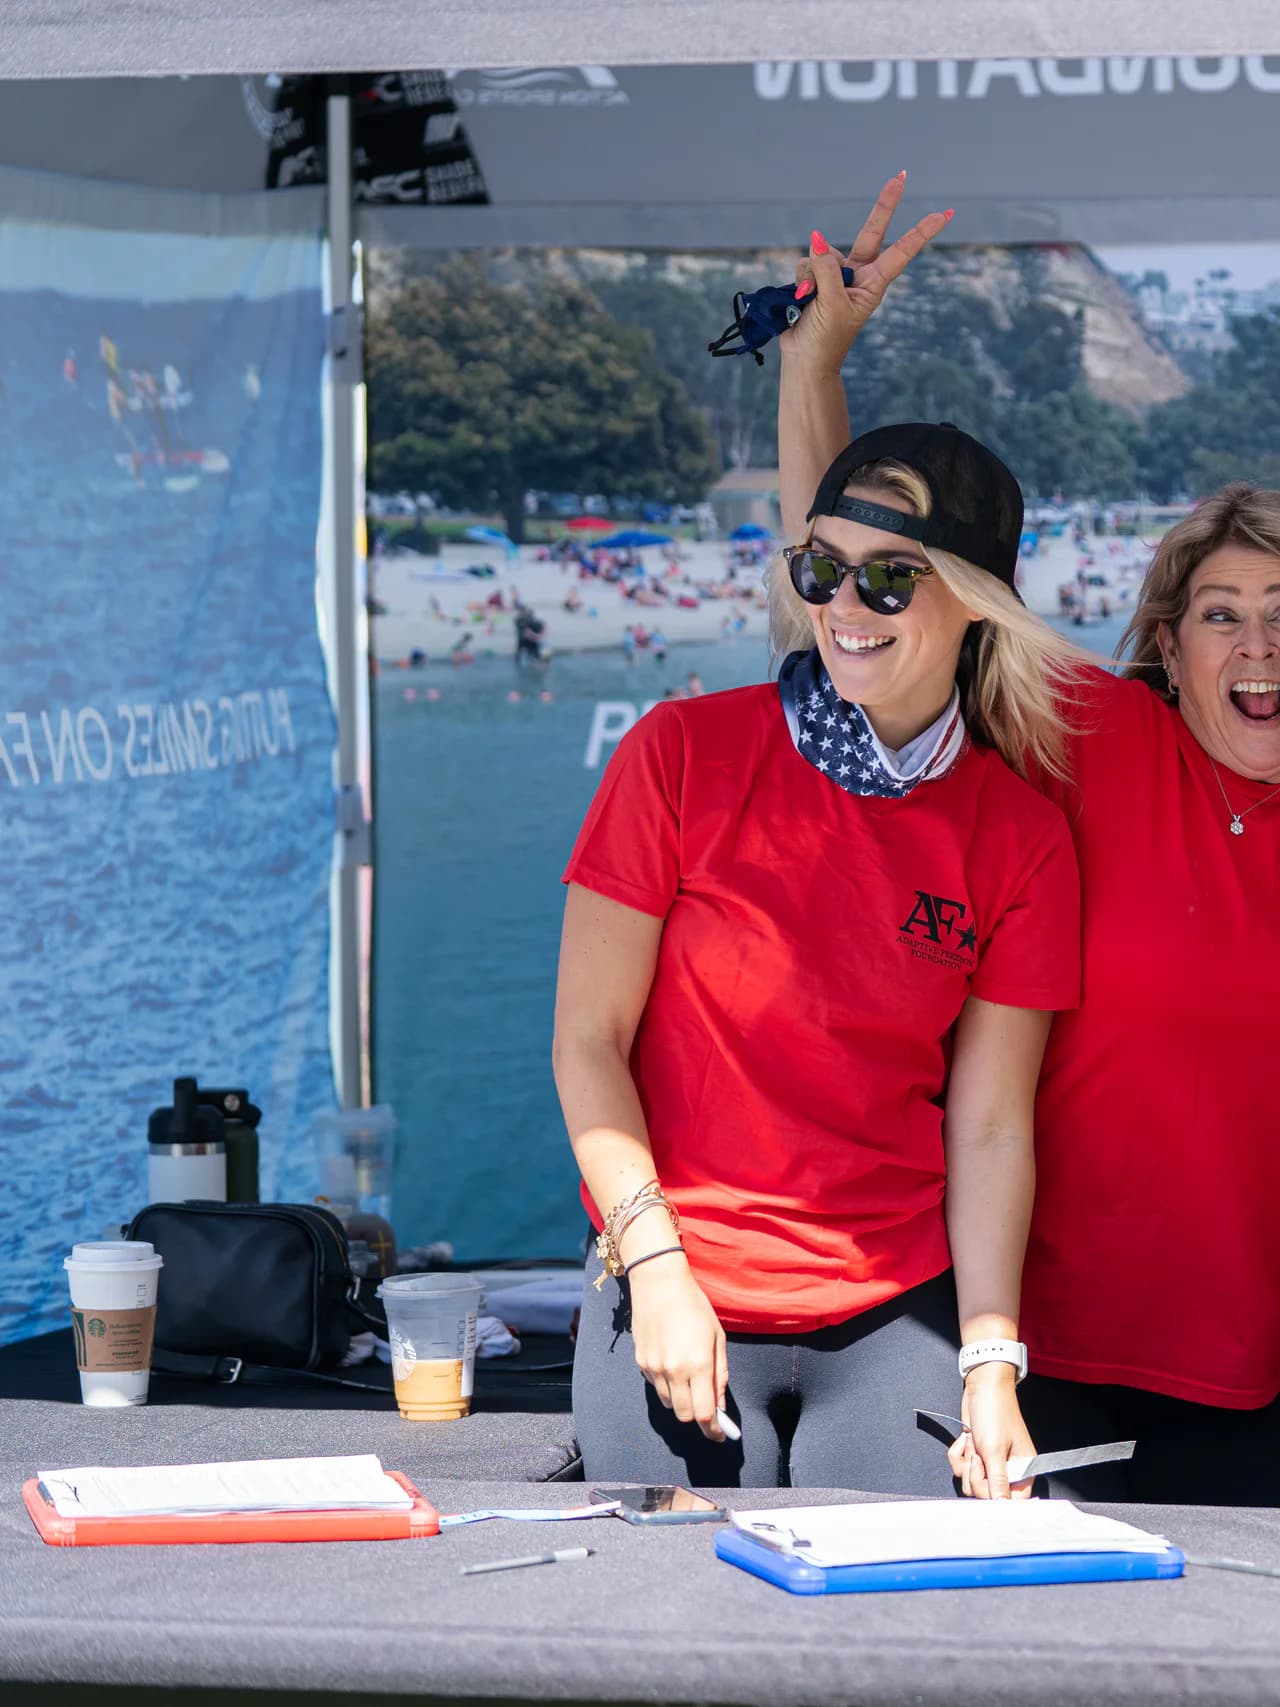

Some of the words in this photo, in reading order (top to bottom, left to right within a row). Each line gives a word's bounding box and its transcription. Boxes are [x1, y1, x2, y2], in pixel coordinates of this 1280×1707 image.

[899, 889, 967, 945] AF
[896, 935, 939, 955] ADAPTIVE
[911, 949, 962, 972] FOUNDATION
